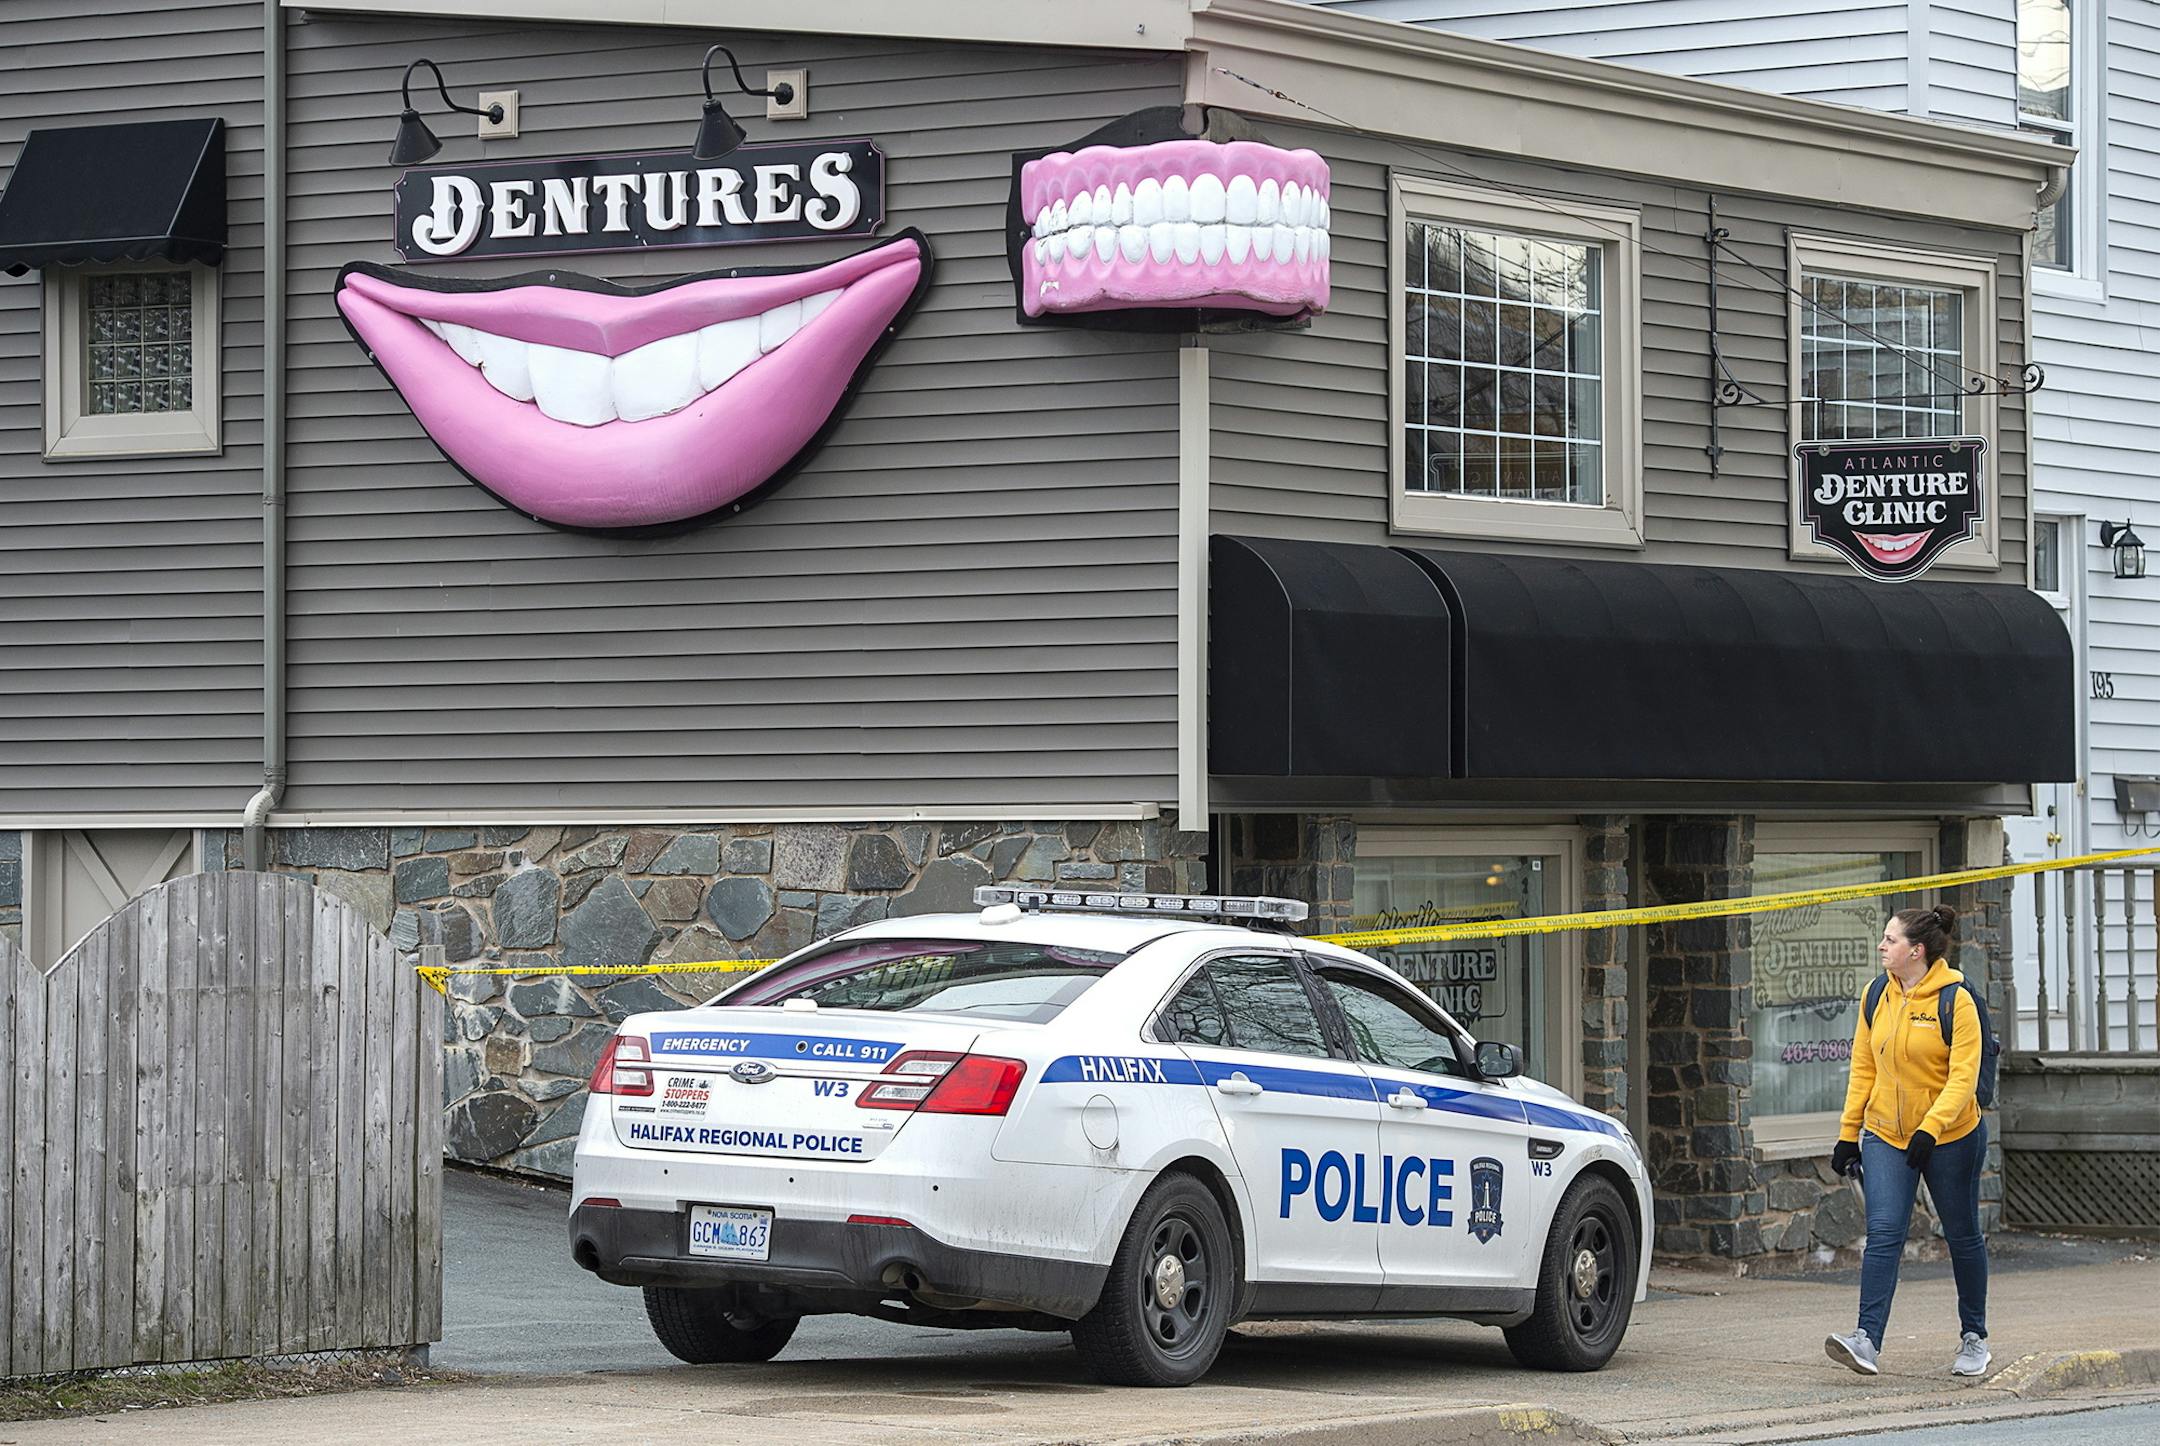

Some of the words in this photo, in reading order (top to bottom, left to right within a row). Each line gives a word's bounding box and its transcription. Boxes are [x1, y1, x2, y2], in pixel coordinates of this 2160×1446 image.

[411, 151, 861, 257] DENTURES
[1844, 454, 1944, 470] ATLANTIC
[1813, 472, 1969, 505] DENTURE
[1842, 500, 1947, 526] CLINIC
[2092, 671, 2114, 699] 195
[1764, 937, 1869, 976] DENTURE
[1785, 969, 1857, 1001] CLINIC
[662, 1038, 750, 1052] EMERGENCY
[812, 1043, 855, 1057] CALL
[860, 1047, 887, 1060] 911
[1781, 1038, 1854, 1065] 464-080
[737, 1063, 761, 1074] Ford
[1079, 1056, 1168, 1083] HALIFAX
[668, 1077, 695, 1088] CRIME
[813, 1080, 849, 1098] W3
[662, 1100, 707, 1110] 1-800-222-8477
[664, 1088, 710, 1101] STOPPERS
[630, 1123, 696, 1143] HALIFAX
[699, 1128, 788, 1149] REGIONAL
[793, 1133, 863, 1153] POLICE
[1531, 1160, 1553, 1177] W3
[1279, 1147, 1455, 1228] POLICE
[712, 1210, 728, 1219] NOVA
[730, 1211, 753, 1220] SCOTIA
[1475, 1210, 1497, 1224] POLICE
[693, 1221, 721, 1244] GCM
[740, 1225, 767, 1247] 863
